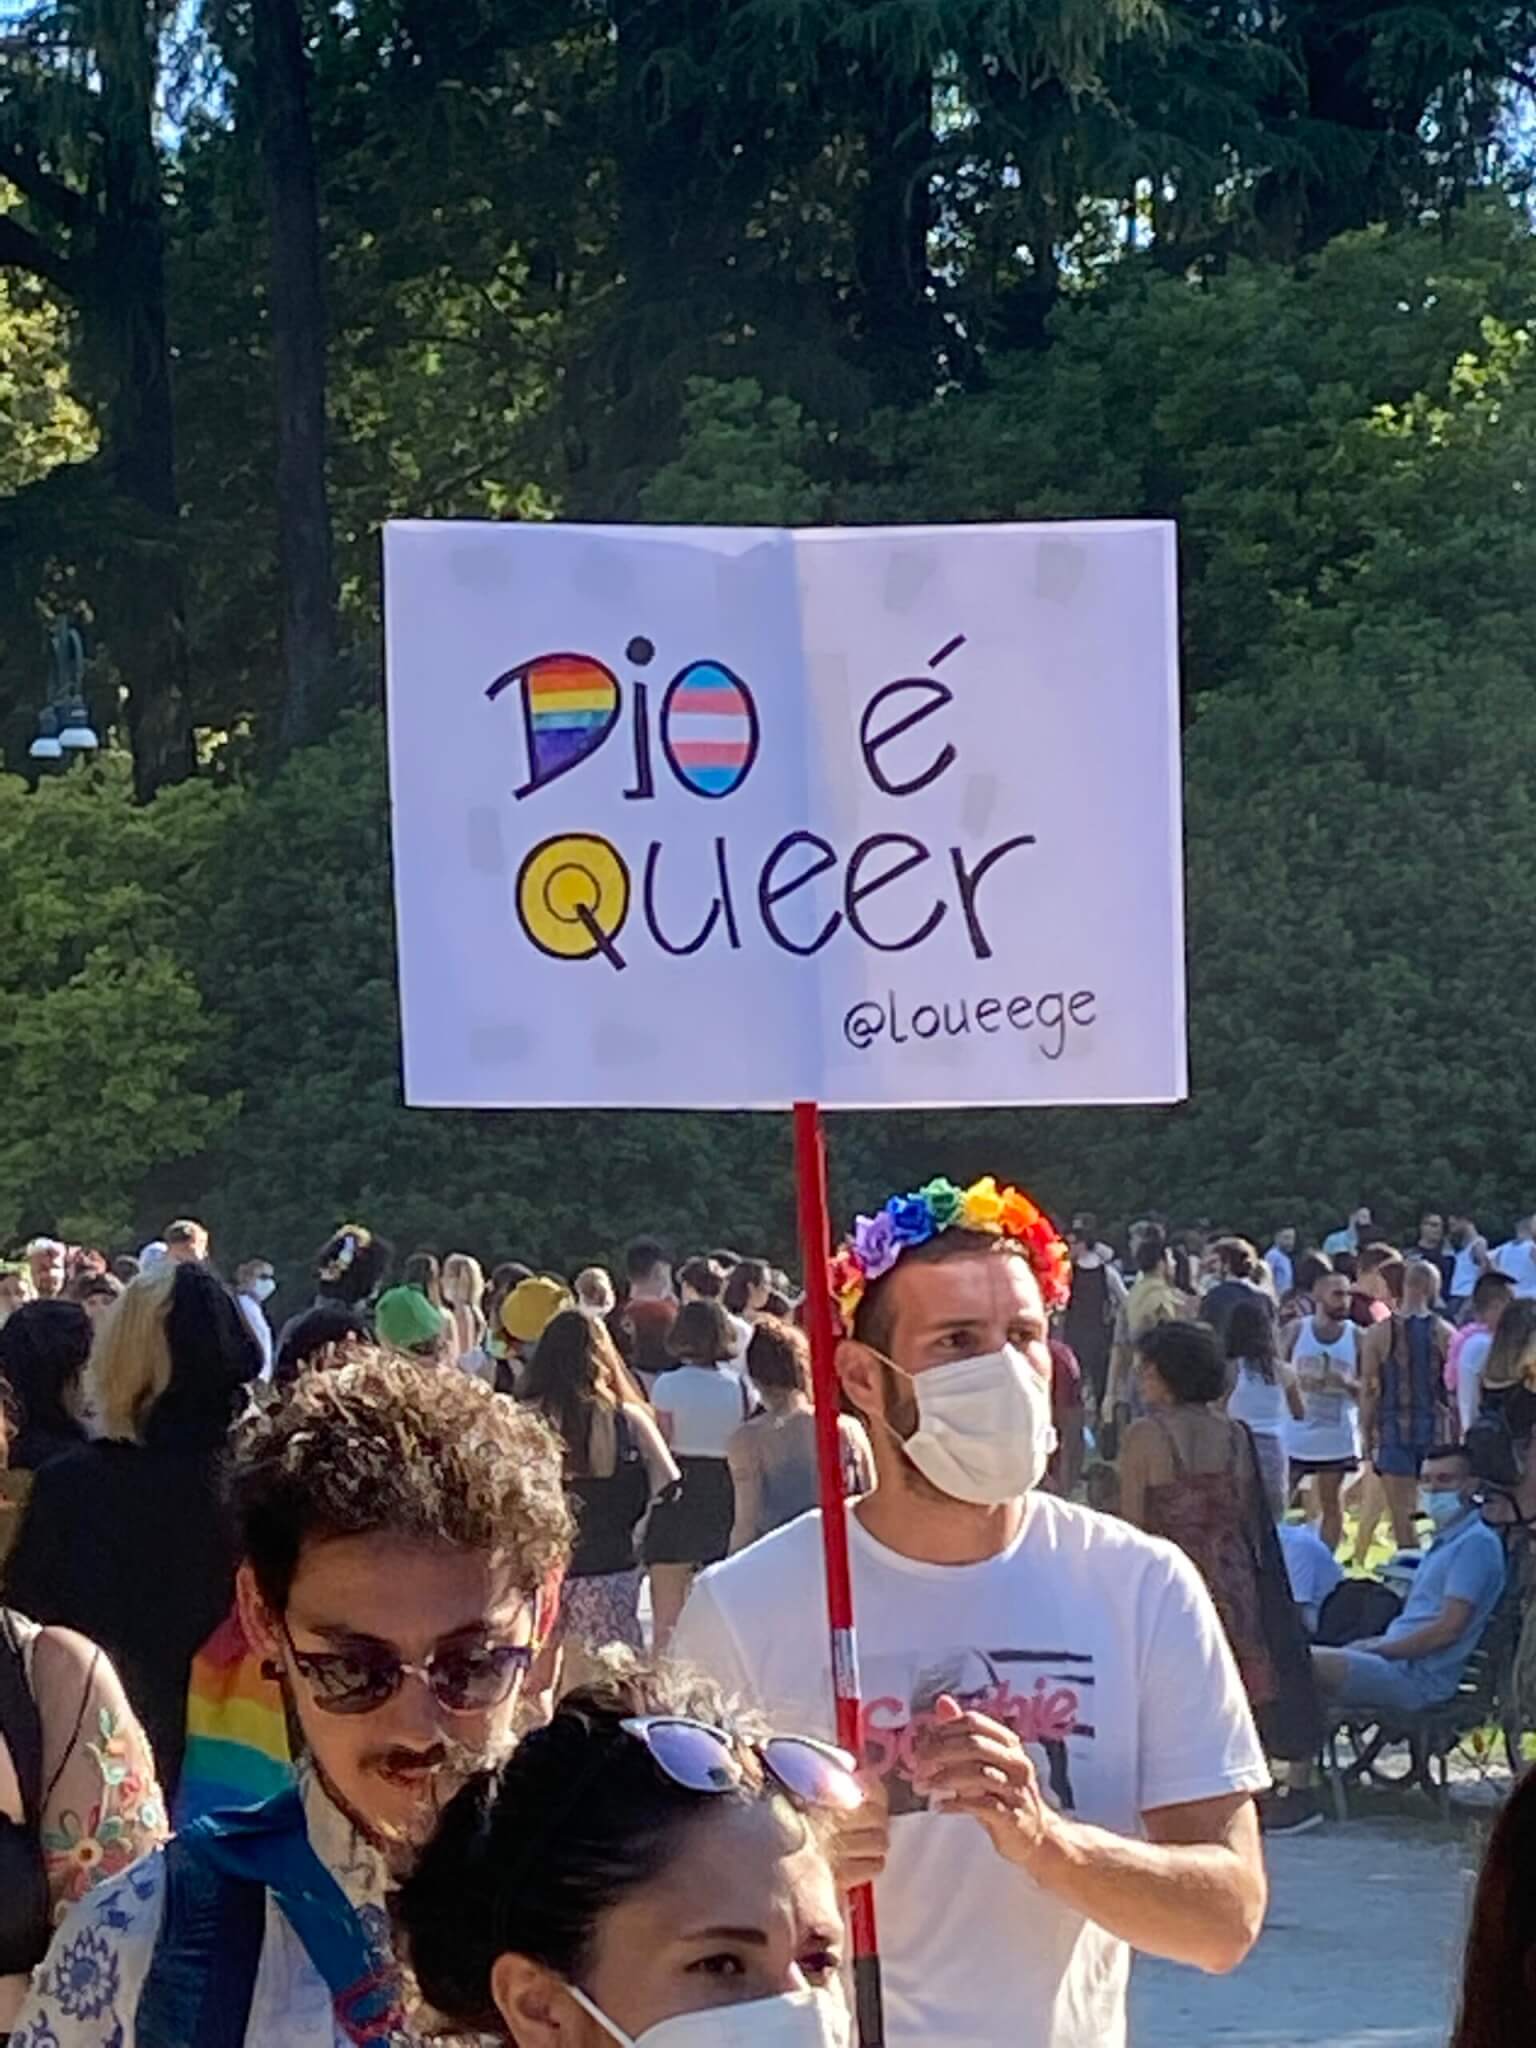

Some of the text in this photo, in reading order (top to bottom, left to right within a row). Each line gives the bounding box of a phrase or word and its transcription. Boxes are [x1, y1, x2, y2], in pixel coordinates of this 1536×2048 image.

[860, 635, 966, 796] é
[514, 830, 1036, 971] Queer
[843, 991, 1095, 1060] @loueege
